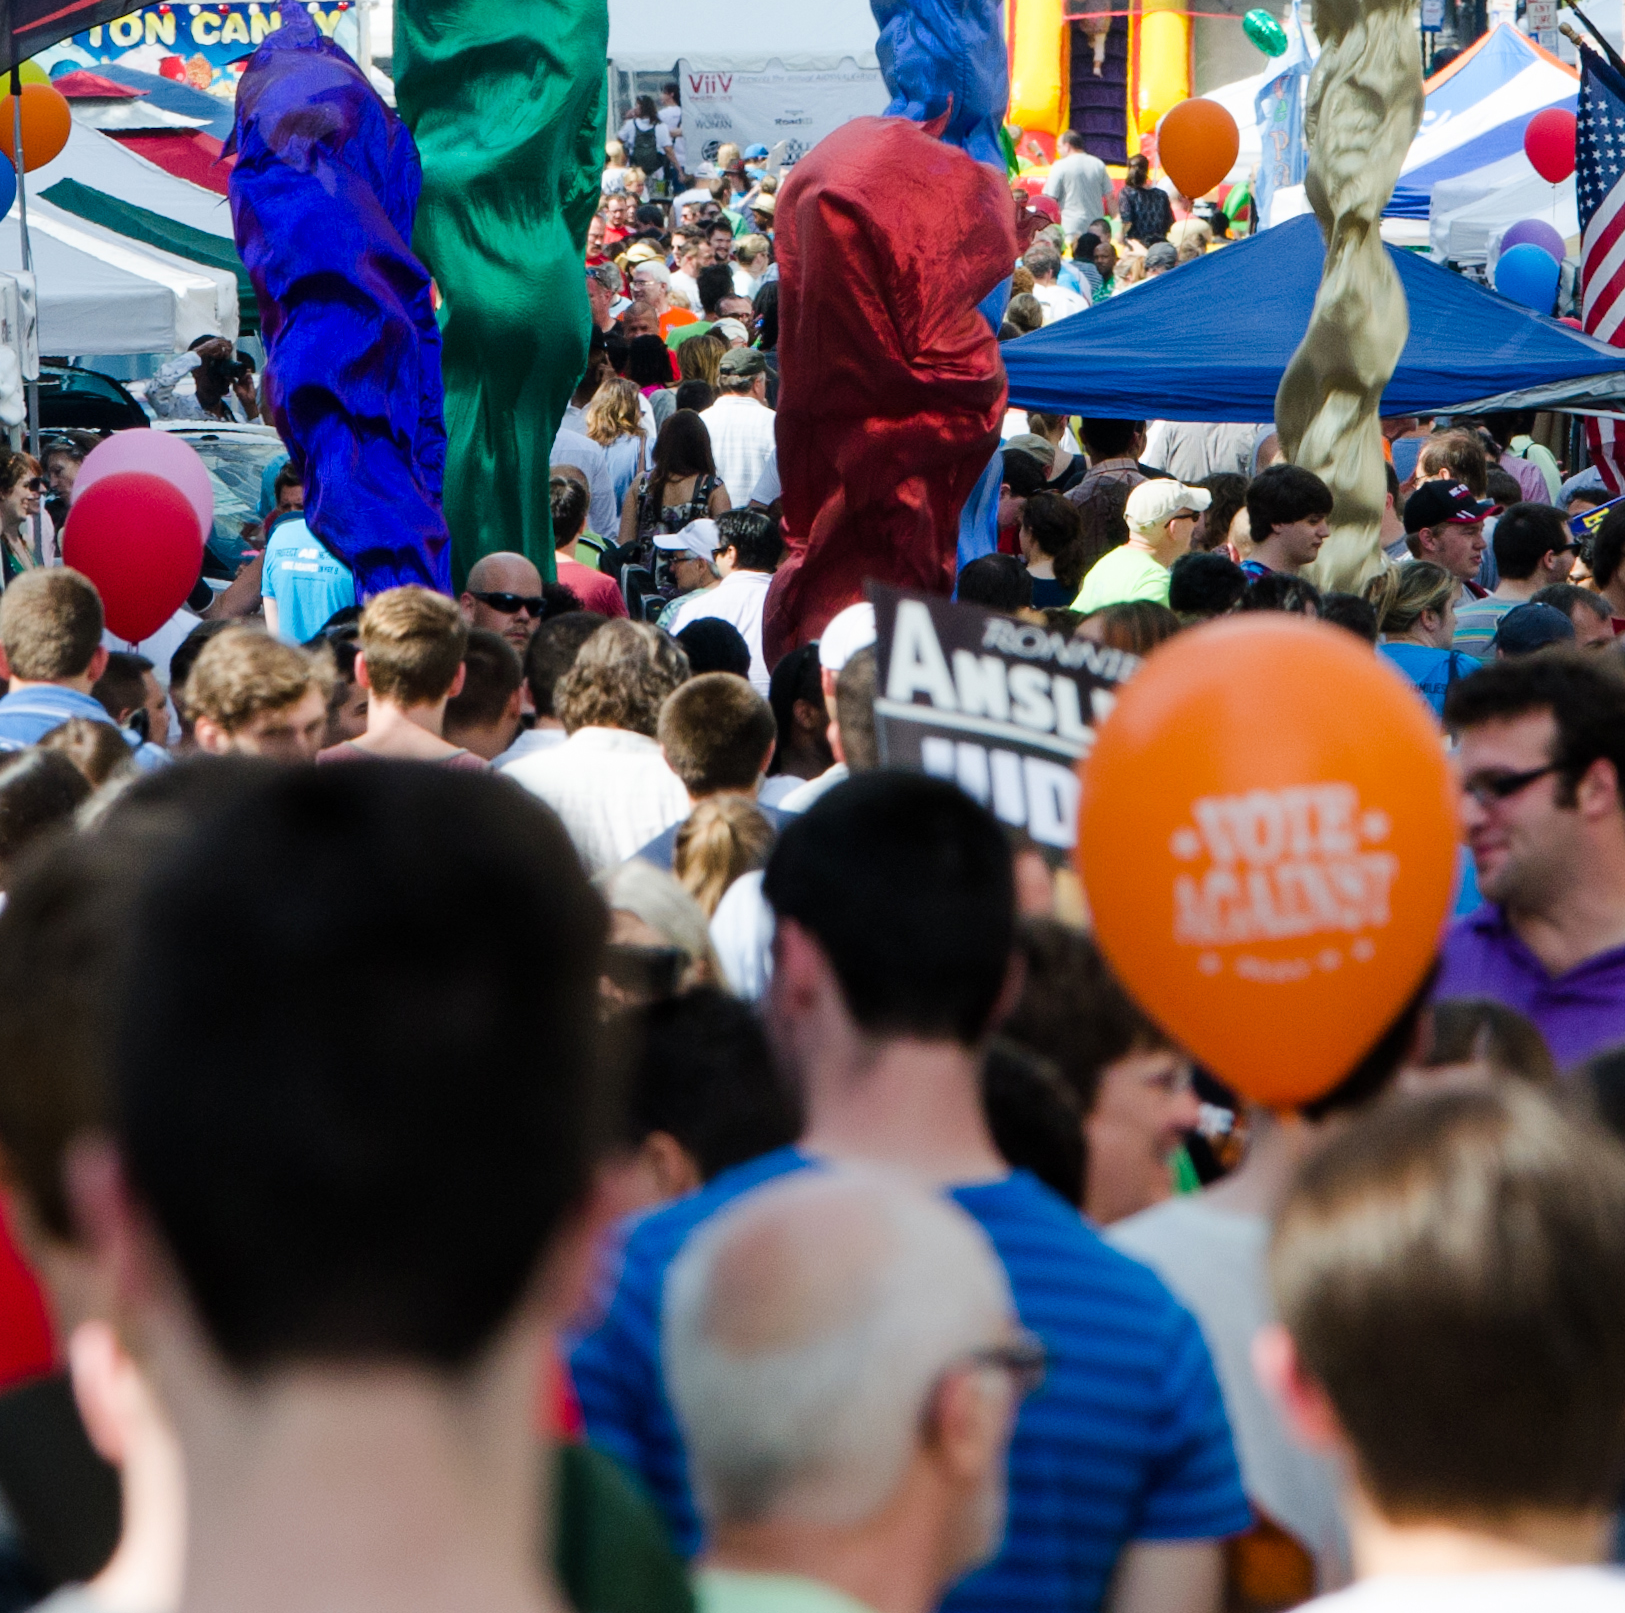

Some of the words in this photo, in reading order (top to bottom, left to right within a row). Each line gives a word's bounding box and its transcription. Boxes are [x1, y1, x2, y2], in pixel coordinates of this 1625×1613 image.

[59, 10, 176, 48] TON
[190, 10, 343, 46] CANY
[688, 72, 733, 95] ViiV
[1191, 782, 1360, 862] VOTE
[1173, 852, 1400, 946] AGAINST
